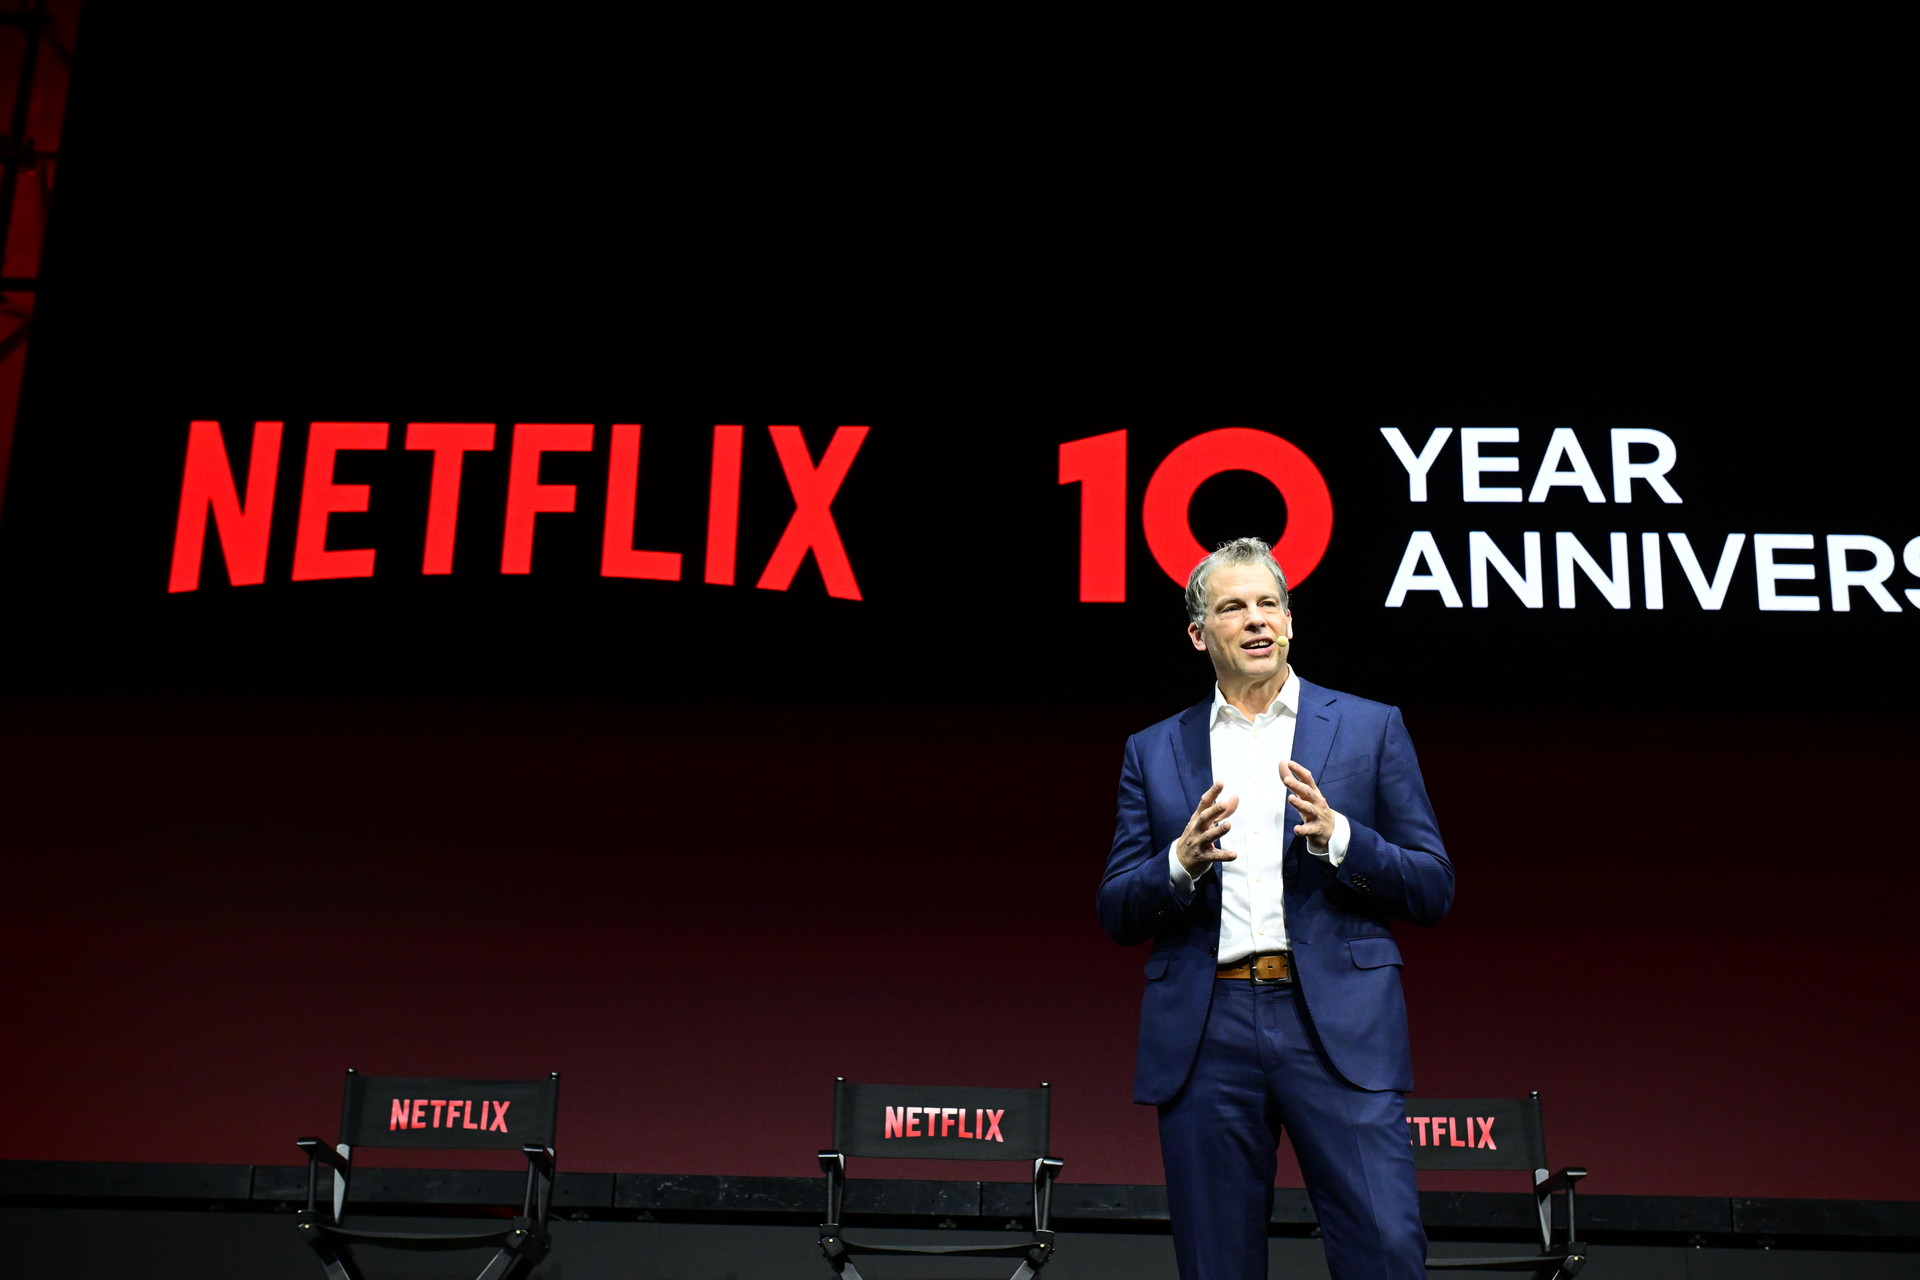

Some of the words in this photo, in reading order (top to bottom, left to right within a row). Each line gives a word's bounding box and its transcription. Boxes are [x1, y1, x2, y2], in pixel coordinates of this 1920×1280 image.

[1380, 427, 1683, 504] YEAR
[168, 420, 870, 601] NETFLIX
[1058, 427, 1333, 603] 10
[389, 1098, 511, 1134] NETFLIX
[884, 1105, 1005, 1143] NETFLIX
[1406, 1116, 1497, 1151] TFLIX
